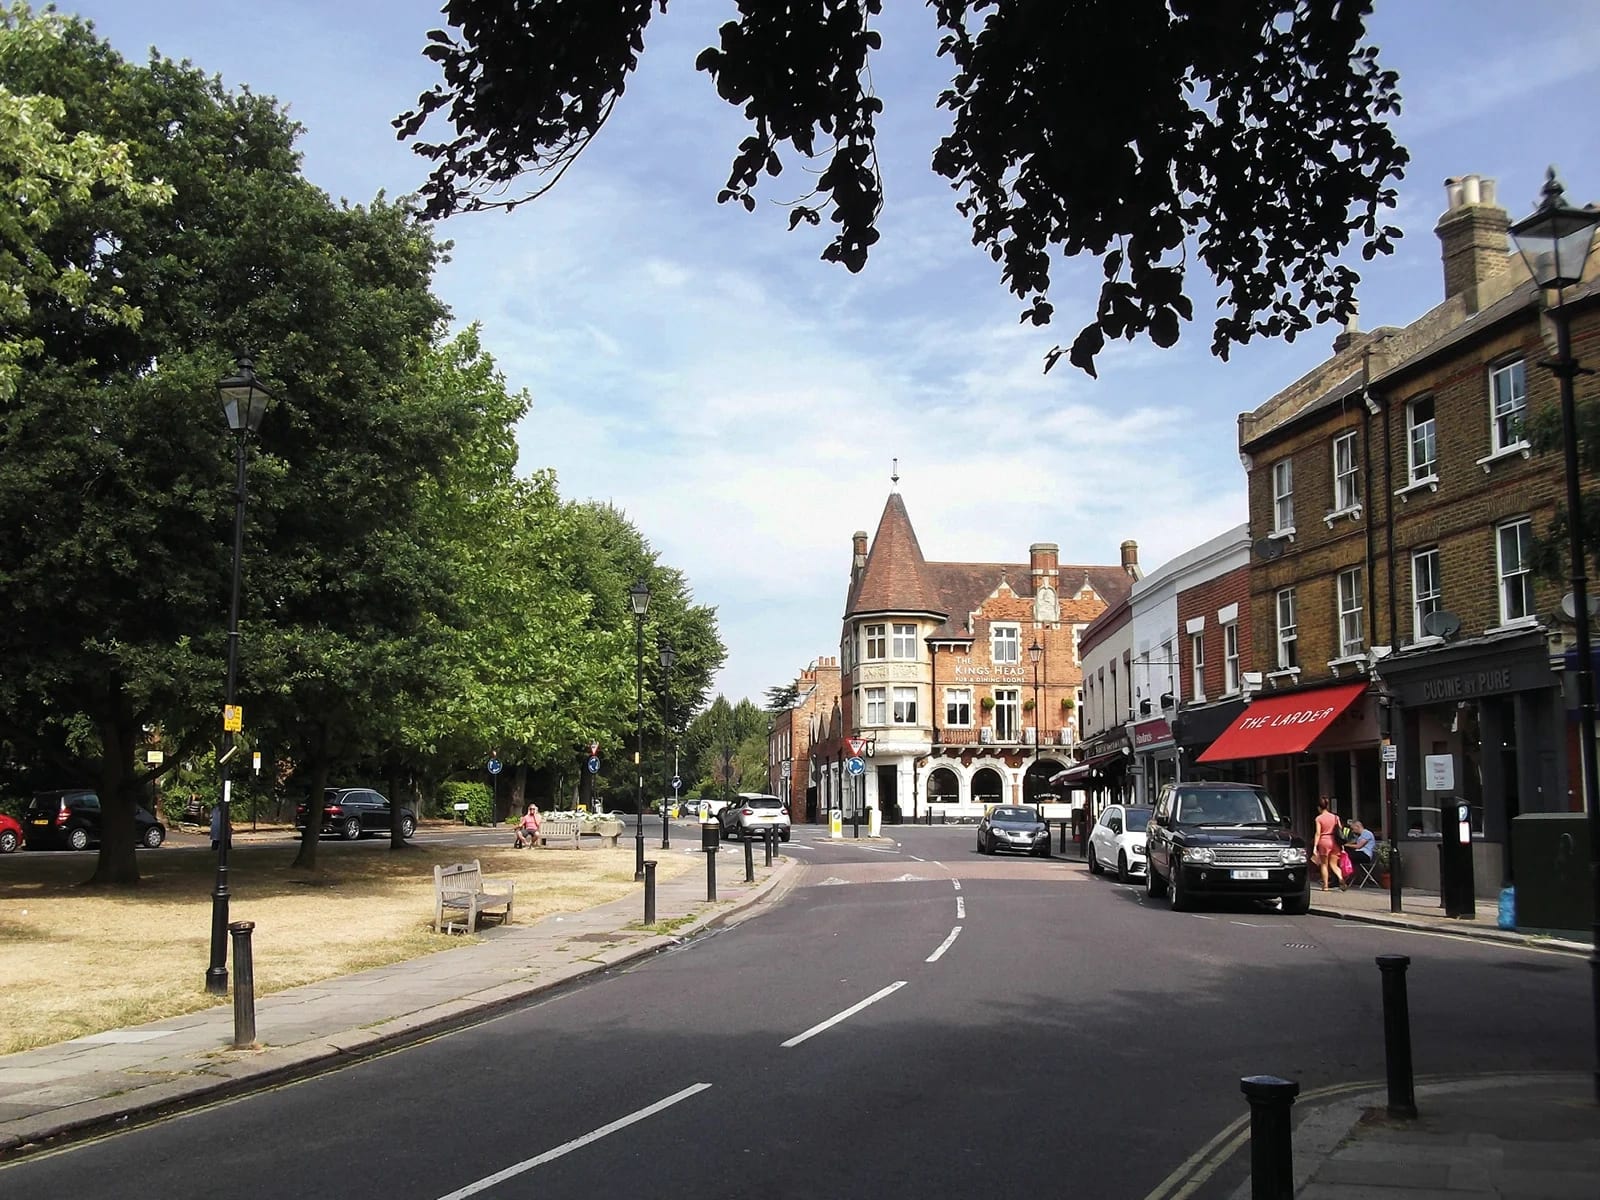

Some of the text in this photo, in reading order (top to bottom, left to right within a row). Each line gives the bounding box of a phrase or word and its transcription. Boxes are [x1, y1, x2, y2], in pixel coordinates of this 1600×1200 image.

[956, 656, 972, 664] THE
[955, 665, 1025, 675] KINGS HEAD
[1423, 677, 1462, 700] CUCINE
[1479, 669, 1511, 692] PURE
[1239, 707, 1334, 730] THE LARDER
